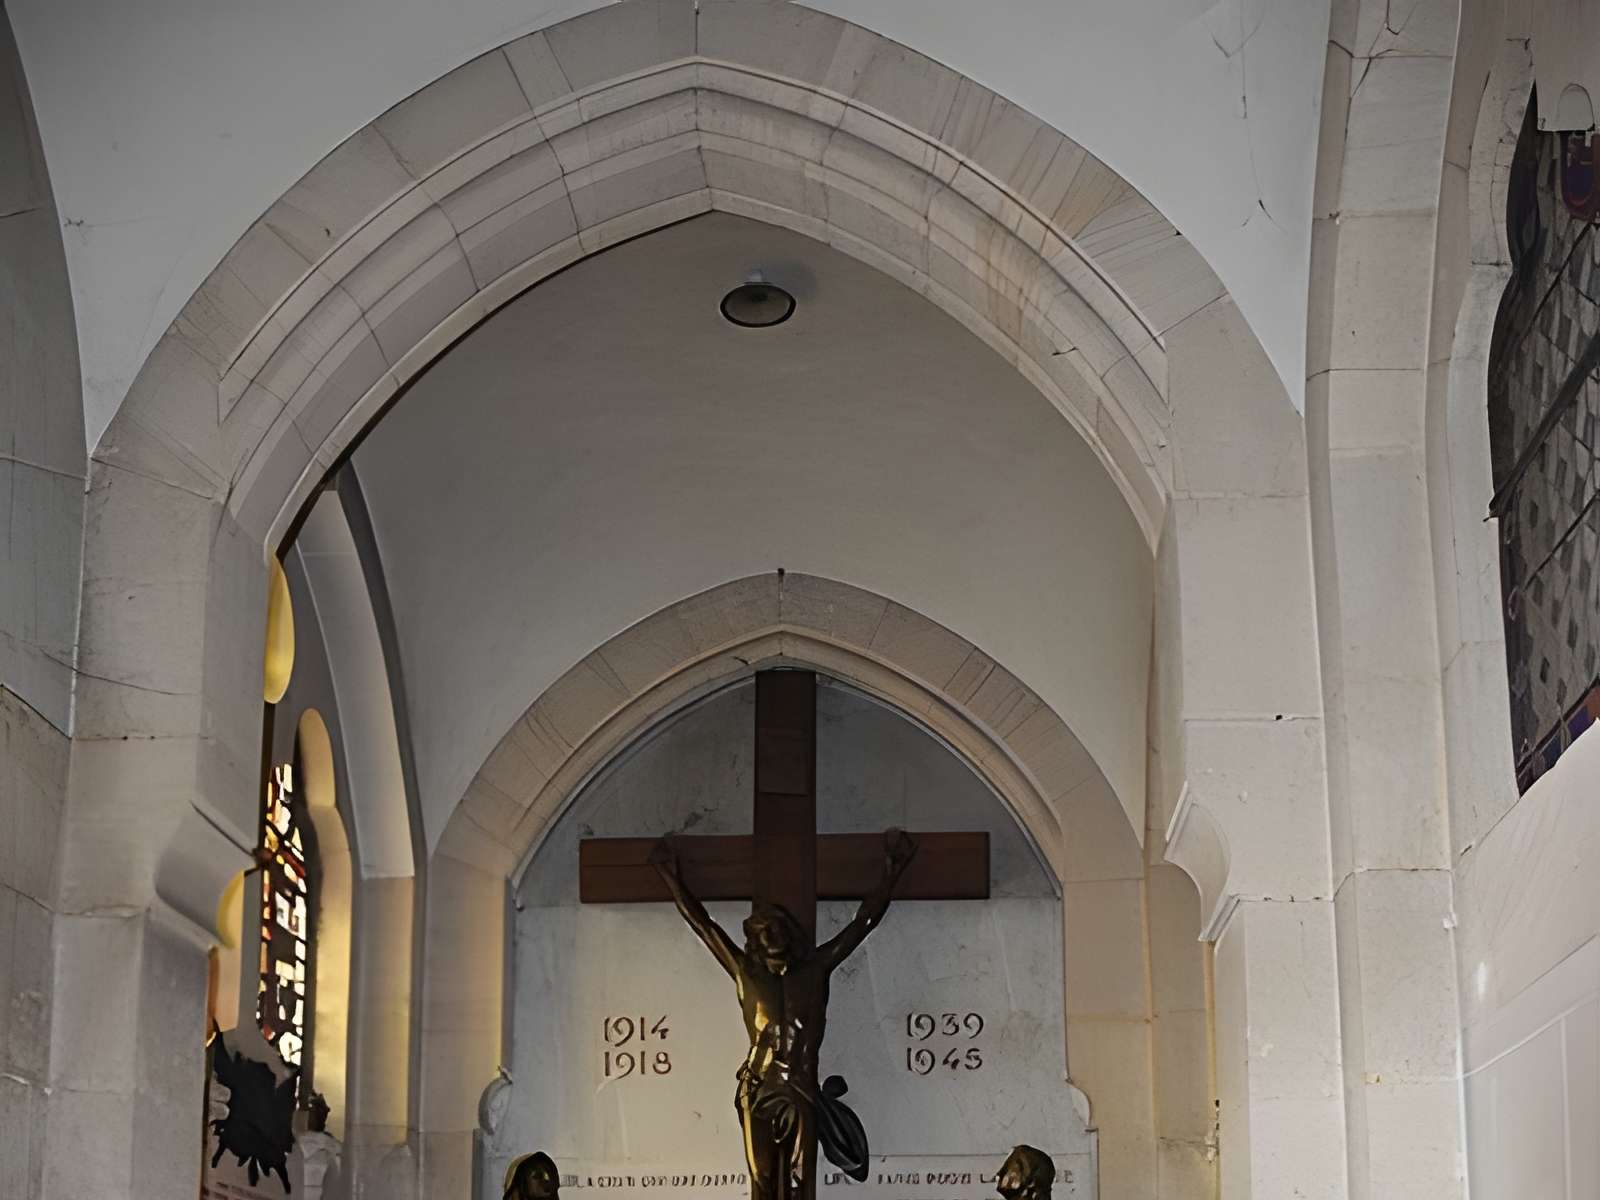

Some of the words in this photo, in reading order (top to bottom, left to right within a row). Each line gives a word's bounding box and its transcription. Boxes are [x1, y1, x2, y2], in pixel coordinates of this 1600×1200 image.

[604, 1015, 670, 1047] 1914
[907, 1012, 984, 1040] 1939
[604, 1051, 672, 1080] 1918
[907, 1047, 983, 1075] 1945
